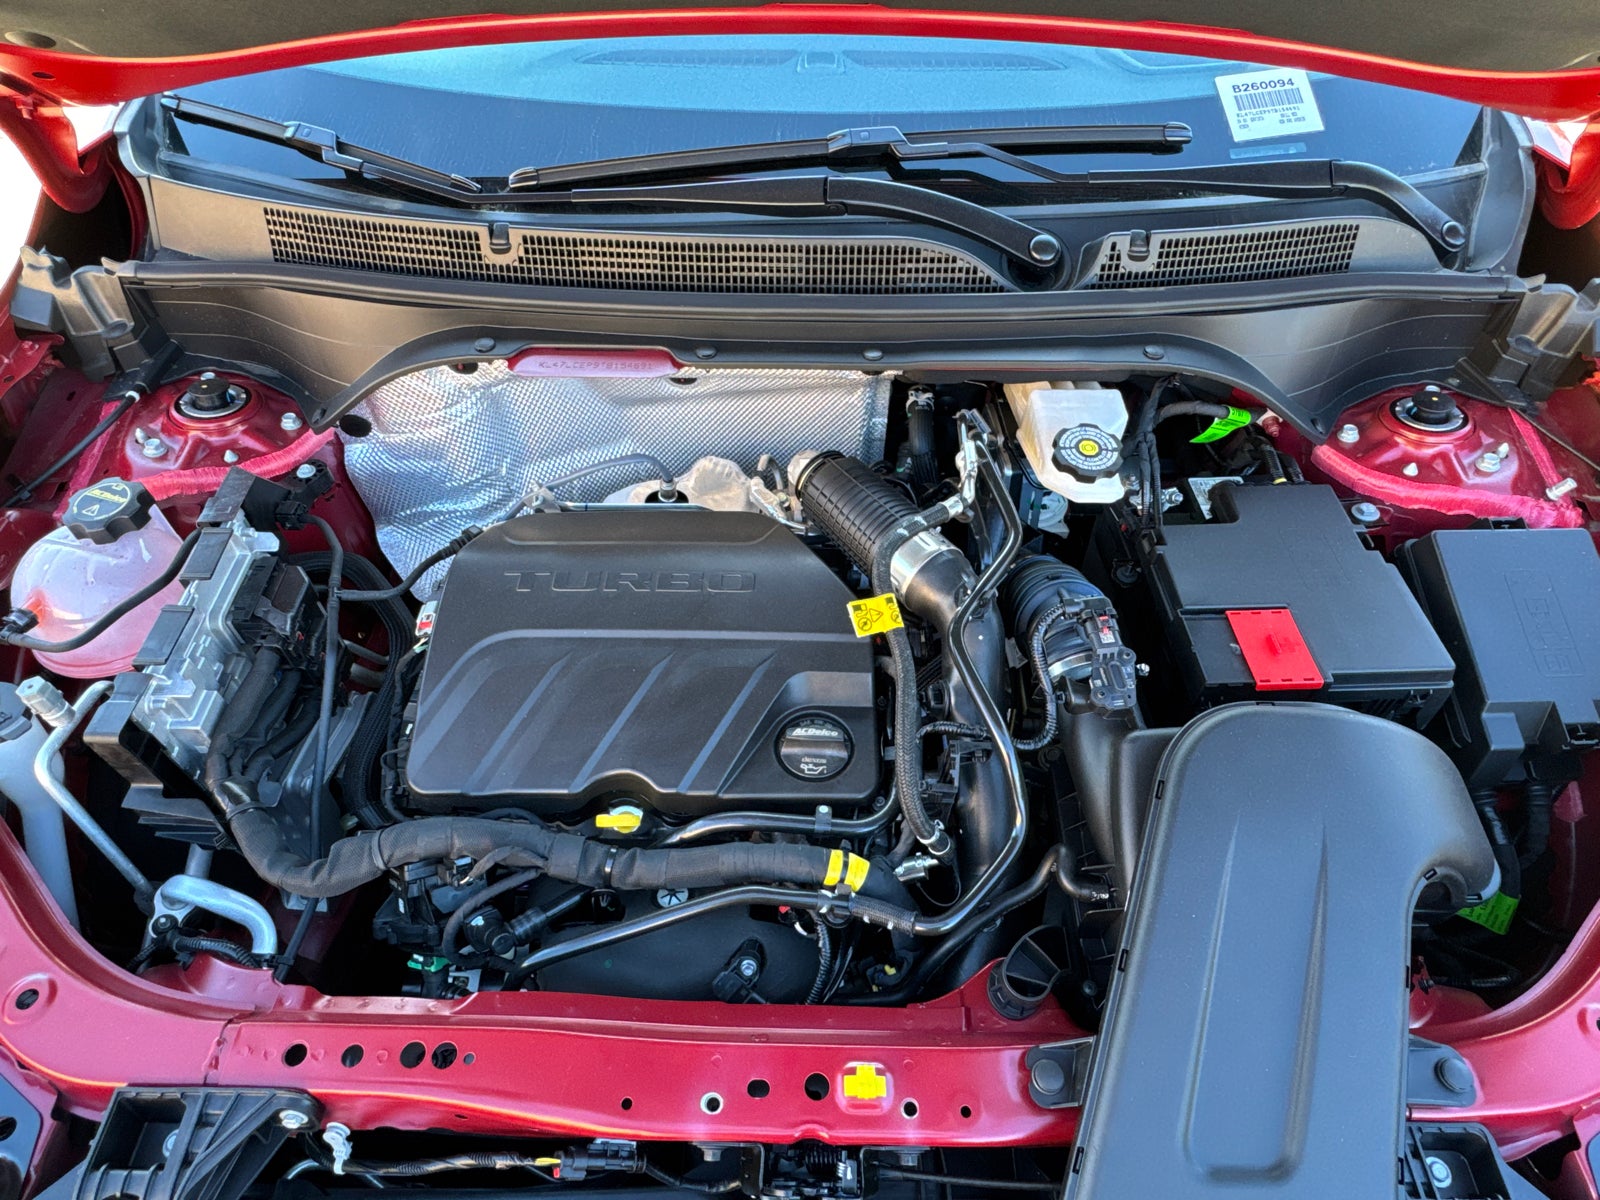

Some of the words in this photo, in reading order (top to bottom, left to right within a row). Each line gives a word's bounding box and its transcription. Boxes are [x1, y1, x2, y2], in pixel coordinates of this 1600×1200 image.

[1232, 78, 1295, 94] B260094
[504, 571, 756, 593] TURBO
[792, 727, 839, 737] ACDelco
